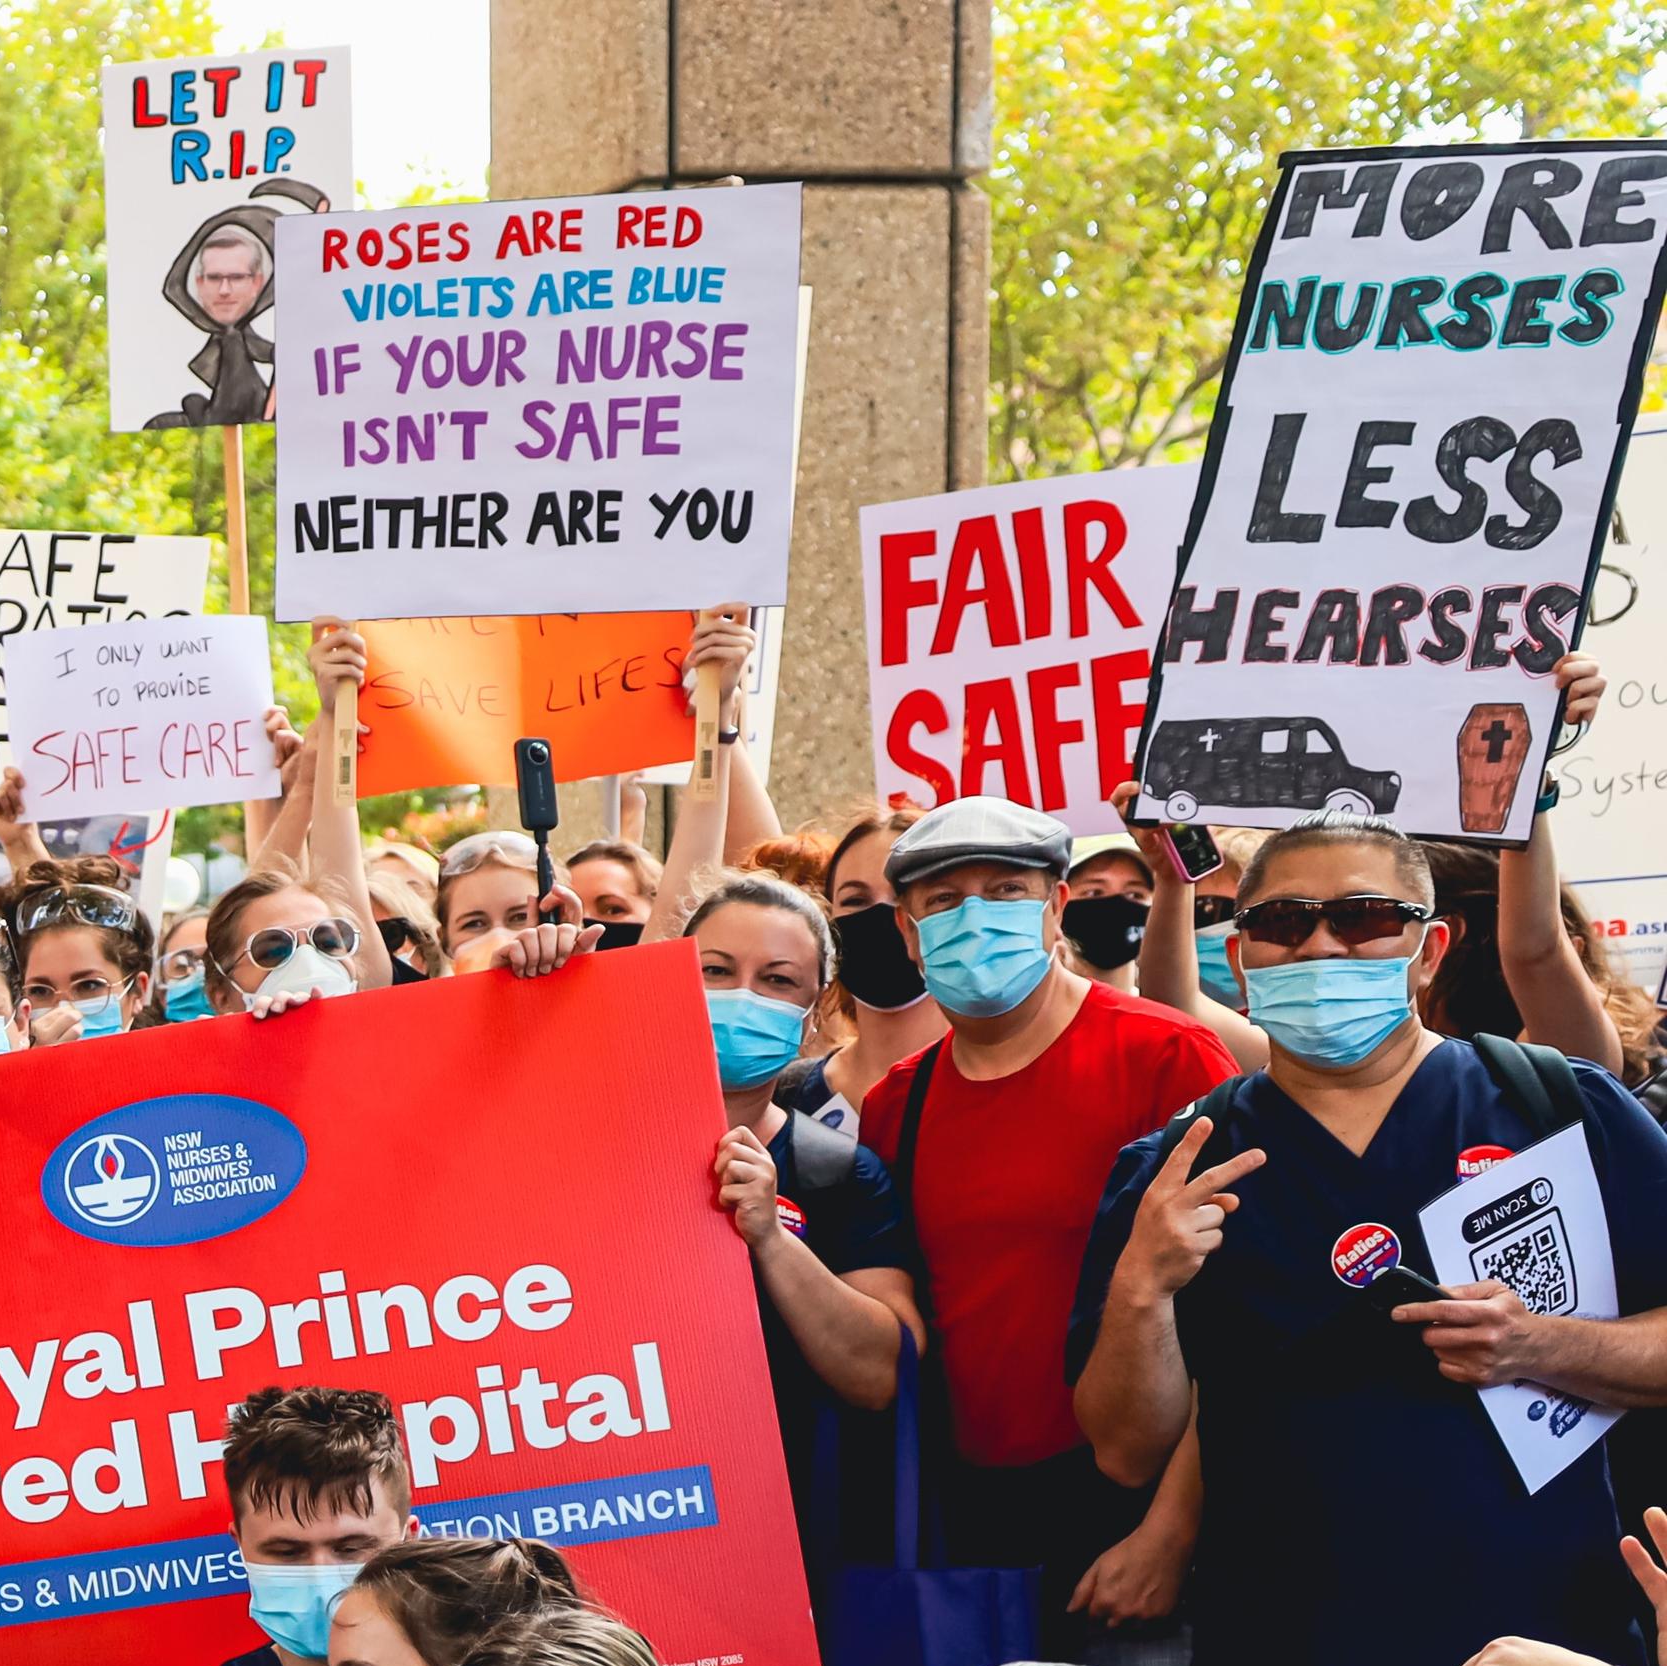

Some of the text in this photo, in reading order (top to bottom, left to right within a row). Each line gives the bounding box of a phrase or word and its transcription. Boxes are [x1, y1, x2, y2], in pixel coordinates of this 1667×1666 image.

[133, 60, 328, 127] LET IT
[1280, 156, 1667, 254] MORE
[322, 205, 704, 273] ROSES ARE RED
[344, 267, 727, 322] VIOLETS ARE BLUE
[1247, 267, 1625, 354] NURSES
[314, 321, 750, 395] IF YOUR NURSE
[344, 396, 681, 467] ISN'T SAFE
[1247, 413, 1584, 552] LESS
[294, 488, 754, 553] NEITHER ARE YOU
[879, 498, 1142, 668] FAIR
[57, 637, 212, 677] I ONLY WANT
[1166, 585, 1584, 676] HEARSES
[94, 685, 122, 707] TO
[367, 672, 504, 716] SAVE
[34, 720, 254, 795] SAFE CARE
[885, 650, 1151, 814] SAFE
[164, 1131, 201, 1152] NSW
[167, 1142, 248, 1170] NURSES &
[173, 1174, 276, 1206] ASSOCIATION
[1473, 1194, 1528, 1232] SCAN ME
[1337, 1231, 1385, 1271] Ratios
[185, 1265, 574, 1371] Prince
[171, 1340, 674, 1498] Hpital
[530, 1484, 706, 1535] BRANCH
[34, 1573, 58, 1607] &
